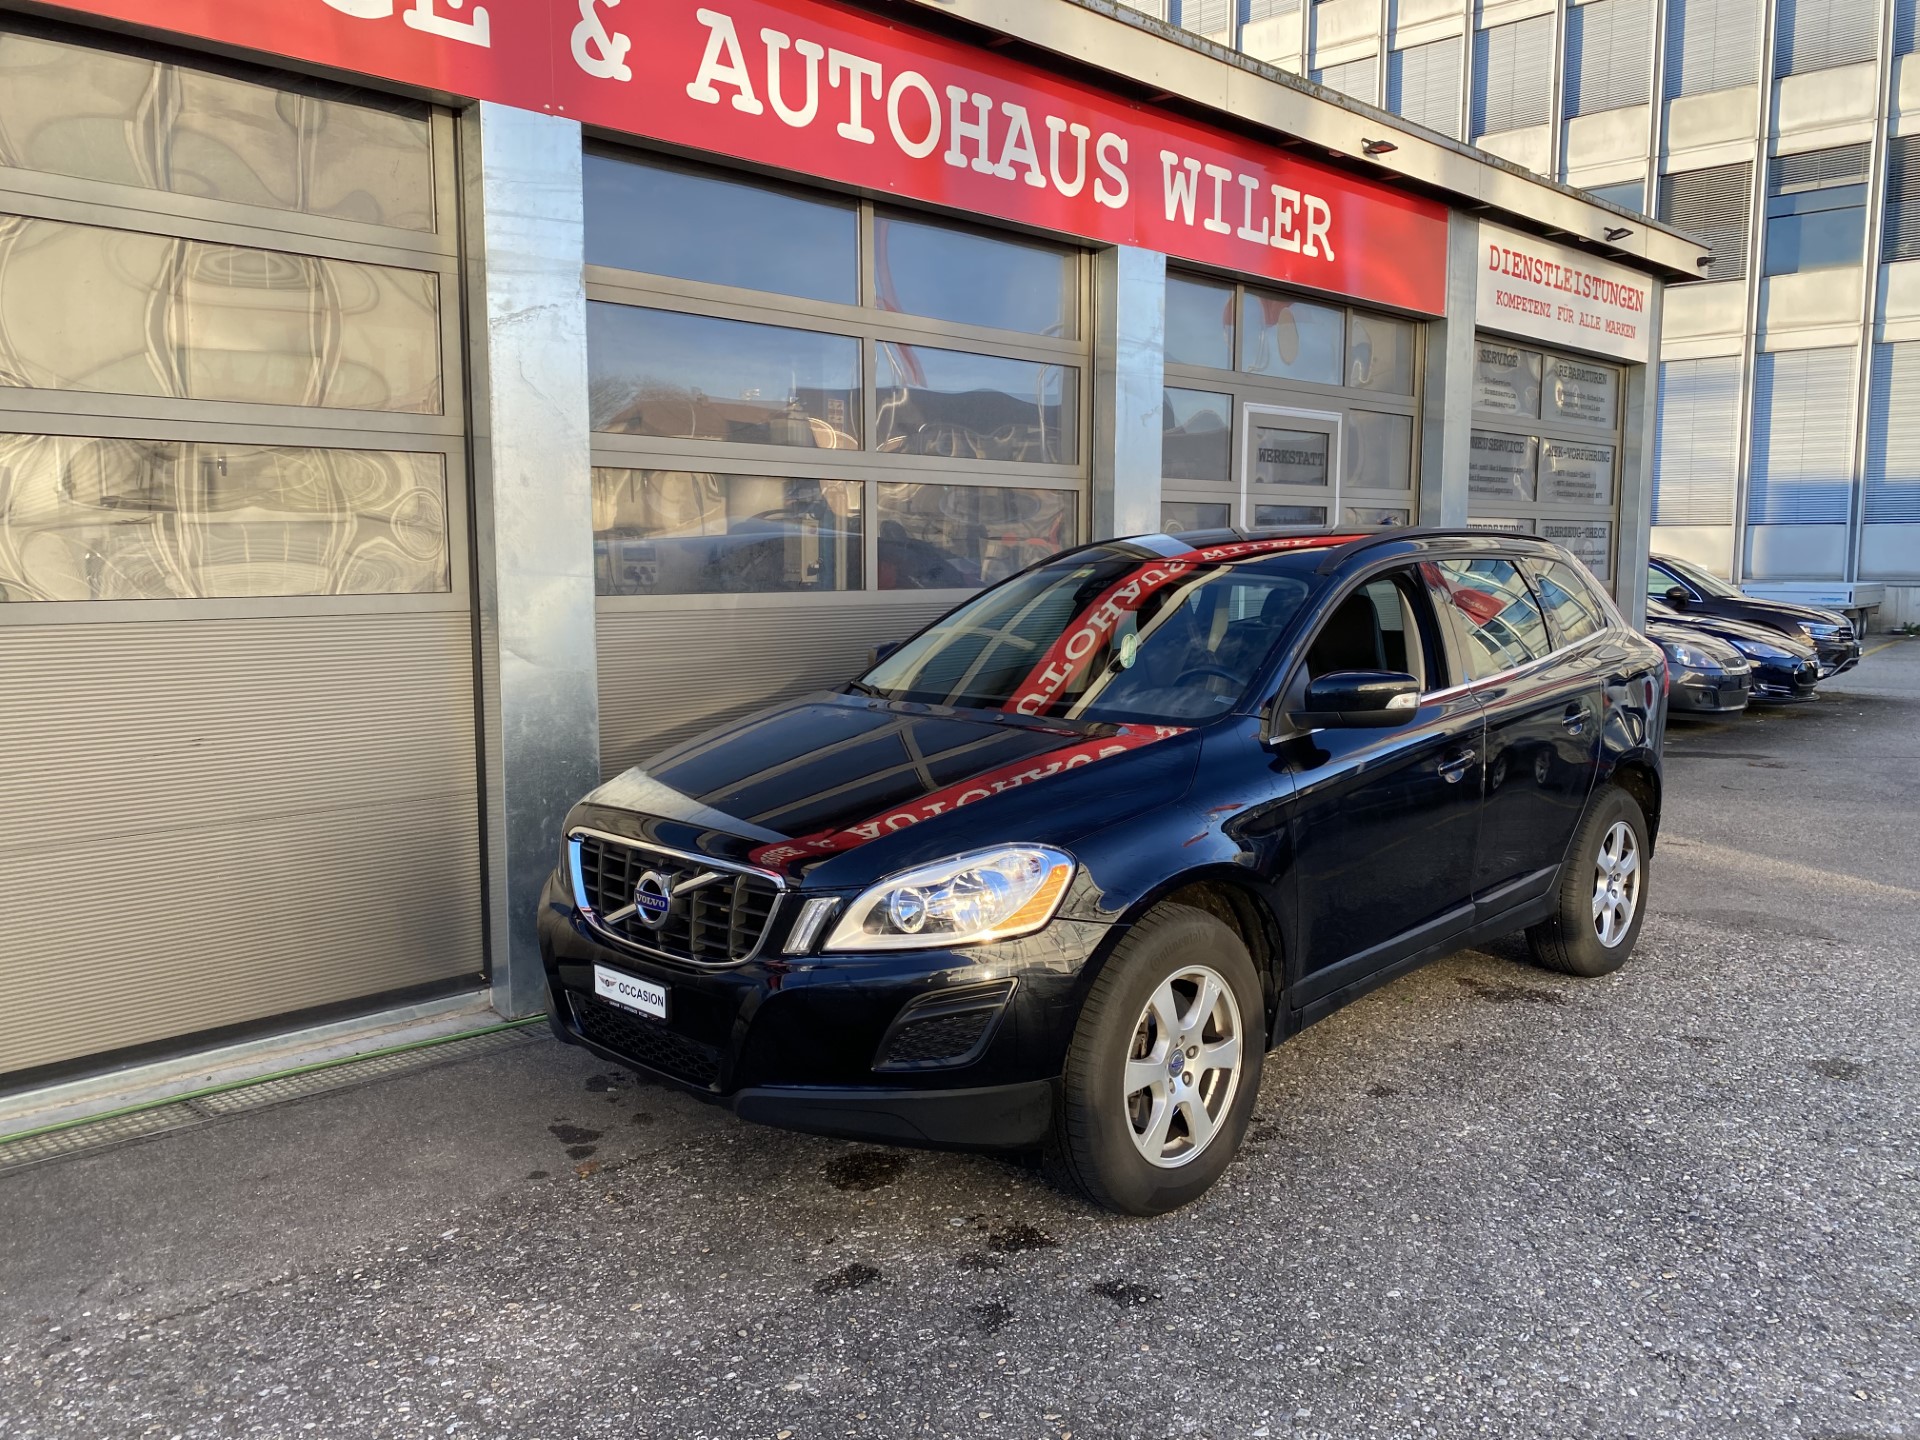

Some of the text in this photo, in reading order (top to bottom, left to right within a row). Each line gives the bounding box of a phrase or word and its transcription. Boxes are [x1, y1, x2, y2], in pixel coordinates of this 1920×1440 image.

[685, 8, 1130, 209] AUTOHAUS
[1159, 149, 1336, 263] WILER
[1489, 245, 1644, 313] DIENSTLEISTUNGEN
[1496, 290, 1636, 339] KOMPETENZ FÜR ALLE MARKEN
[1480, 349, 1518, 368] SERVICE
[1258, 448, 1325, 467] WERKSTATT
[636, 893, 665, 908] VOLVO
[618, 982, 664, 1008] OCCASION
